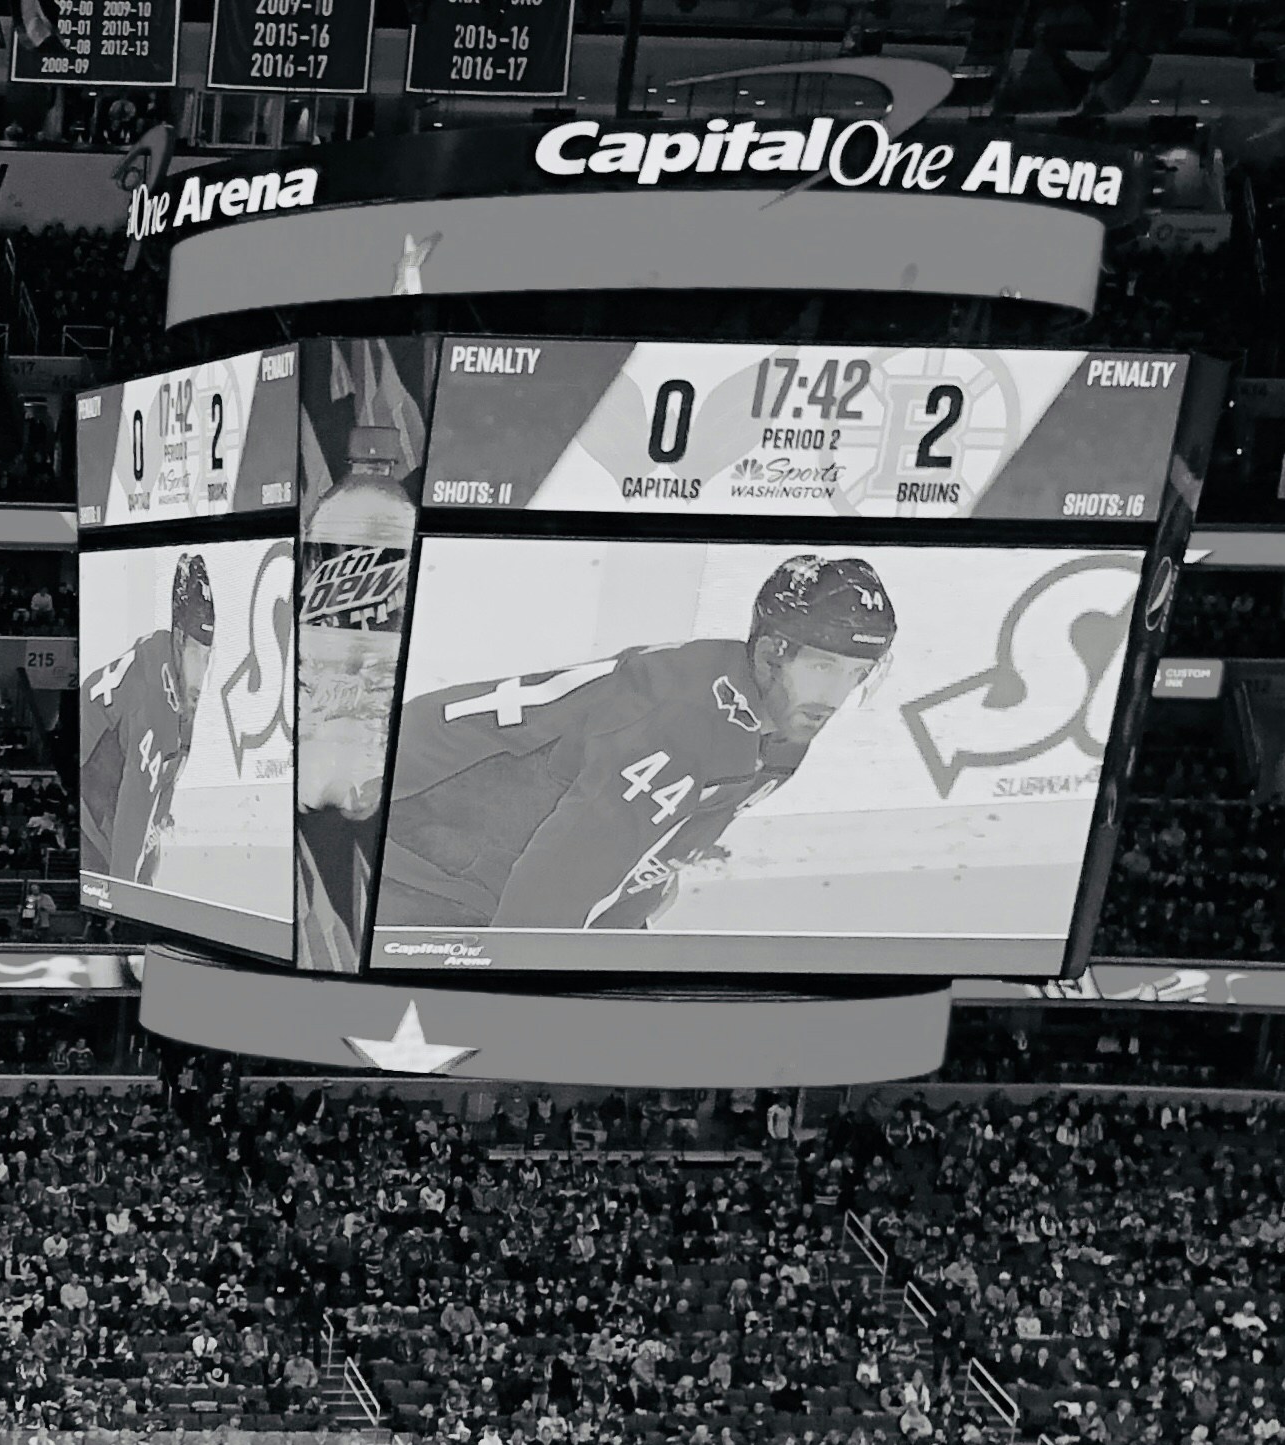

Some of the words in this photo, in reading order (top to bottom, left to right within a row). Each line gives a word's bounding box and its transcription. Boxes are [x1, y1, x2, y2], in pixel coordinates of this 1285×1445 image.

[102, 20, 150, 37] 2010-11
[253, 22, 330, 49] 2015-16
[455, 24, 529, 51] 2015-16
[101, 39, 150, 56] 2012-13
[41, 57, 89, 75] 2008-09
[250, 53, 328, 79] 2016-17
[451, 56, 527, 82] 2016-17
[961, 141, 1123, 206] Arena
[172, 167, 318, 227] Arena
[450, 346, 540, 374] PENALTY
[751, 358, 871, 420] 17:42
[1086, 360, 1177, 389] PENALTY
[133, 409, 144, 481] 0
[211, 393, 223, 470] 2
[648, 379, 696, 464] 0
[915, 384, 964, 469] 2
[762, 429, 825, 450] PERIOD
[829, 429, 841, 450] 2
[764, 457, 847, 483] Sports
[432, 481, 495, 506] SHOTS:
[622, 476, 701, 499] CAPITALS
[731, 485, 835, 499] WASHINGTON
[896, 481, 961, 504] BRUINS
[1062, 492, 1125, 517] SHOTS:
[1126, 493, 1146, 518] 16
[28, 653, 54, 667] 215
[1165, 668, 1211, 678] CUSTOM
[619, 750, 695, 825] 44
